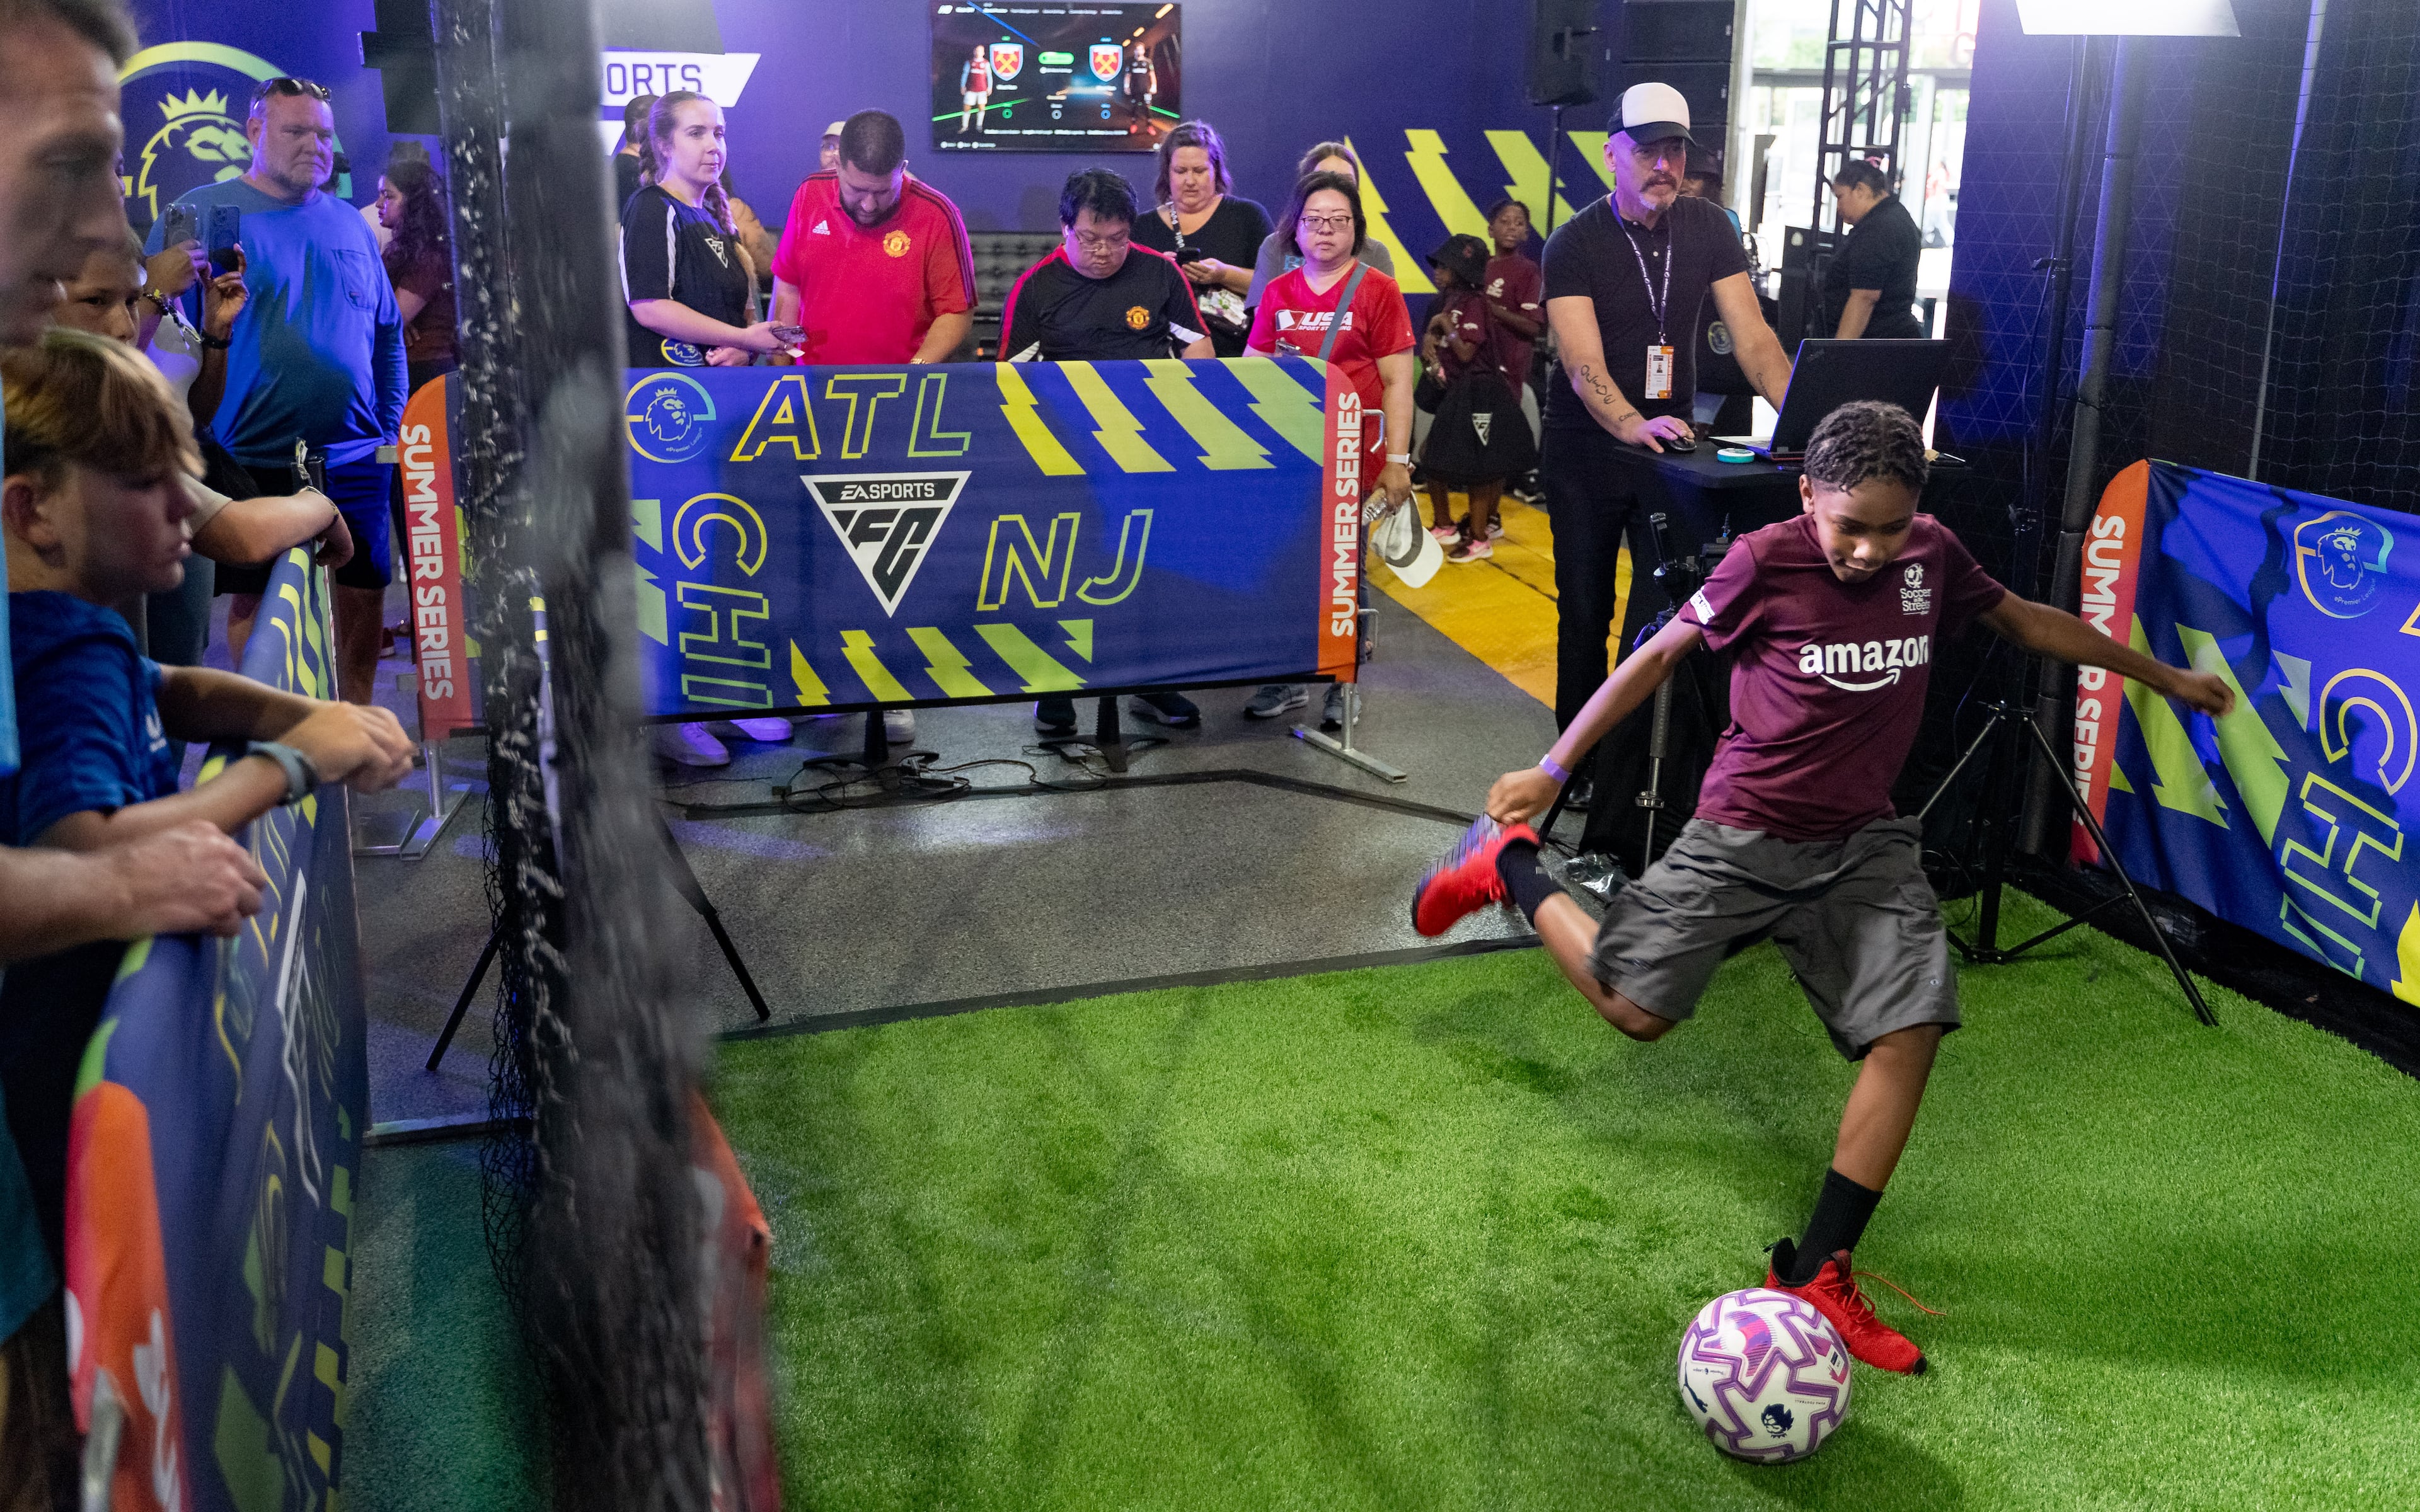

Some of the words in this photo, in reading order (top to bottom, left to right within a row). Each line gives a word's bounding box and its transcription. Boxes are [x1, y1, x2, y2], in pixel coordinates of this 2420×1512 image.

[606, 63, 702, 95] ORTS
[1301, 312, 1353, 326] USA
[729, 373, 972, 461] ATL
[1335, 391, 1362, 496] SERIES
[400, 424, 444, 581] SUMMER
[672, 493, 773, 709] CHI
[848, 507, 943, 604] FC
[976, 508, 1154, 611] NJ
[1331, 502, 1358, 637] SUMMER
[1899, 588, 1932, 598] Soccer
[2077, 514, 2126, 692] SUMMR
[2334, 596, 2361, 605] ePremier
[417, 587, 454, 701] SERIES
[1799, 634, 1929, 675] amazon
[2281, 668, 2418, 981] CHI
